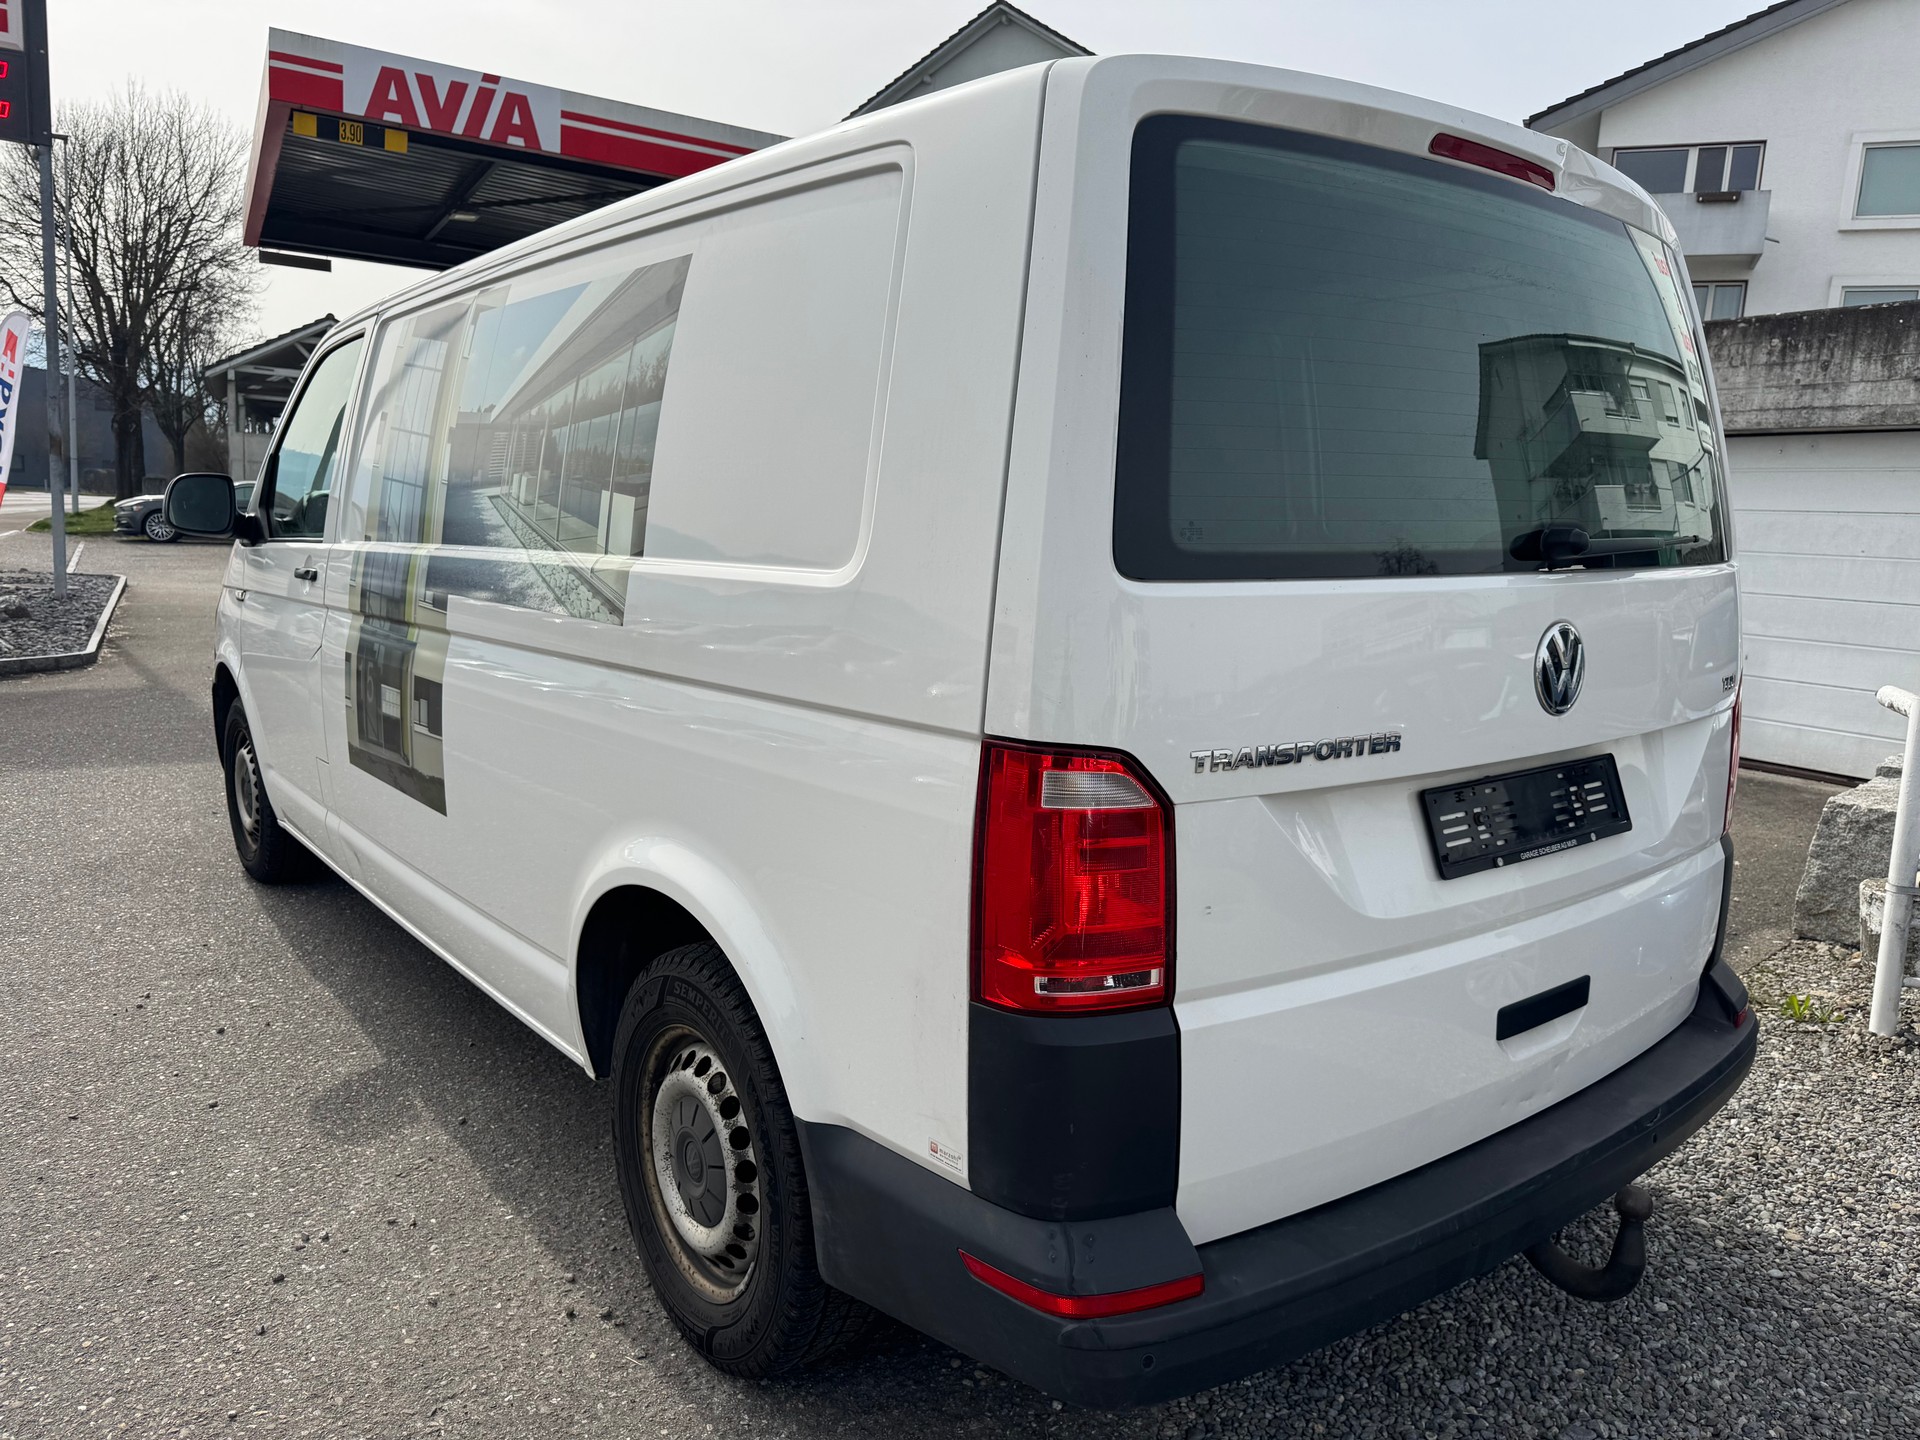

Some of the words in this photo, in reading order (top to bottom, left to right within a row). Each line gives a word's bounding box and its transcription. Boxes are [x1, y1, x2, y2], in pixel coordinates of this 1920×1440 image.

[363, 65, 543, 151] AVIA
[1189, 730, 1402, 774] TRANSPORTER
[1520, 850, 1540, 860] GARAGE
